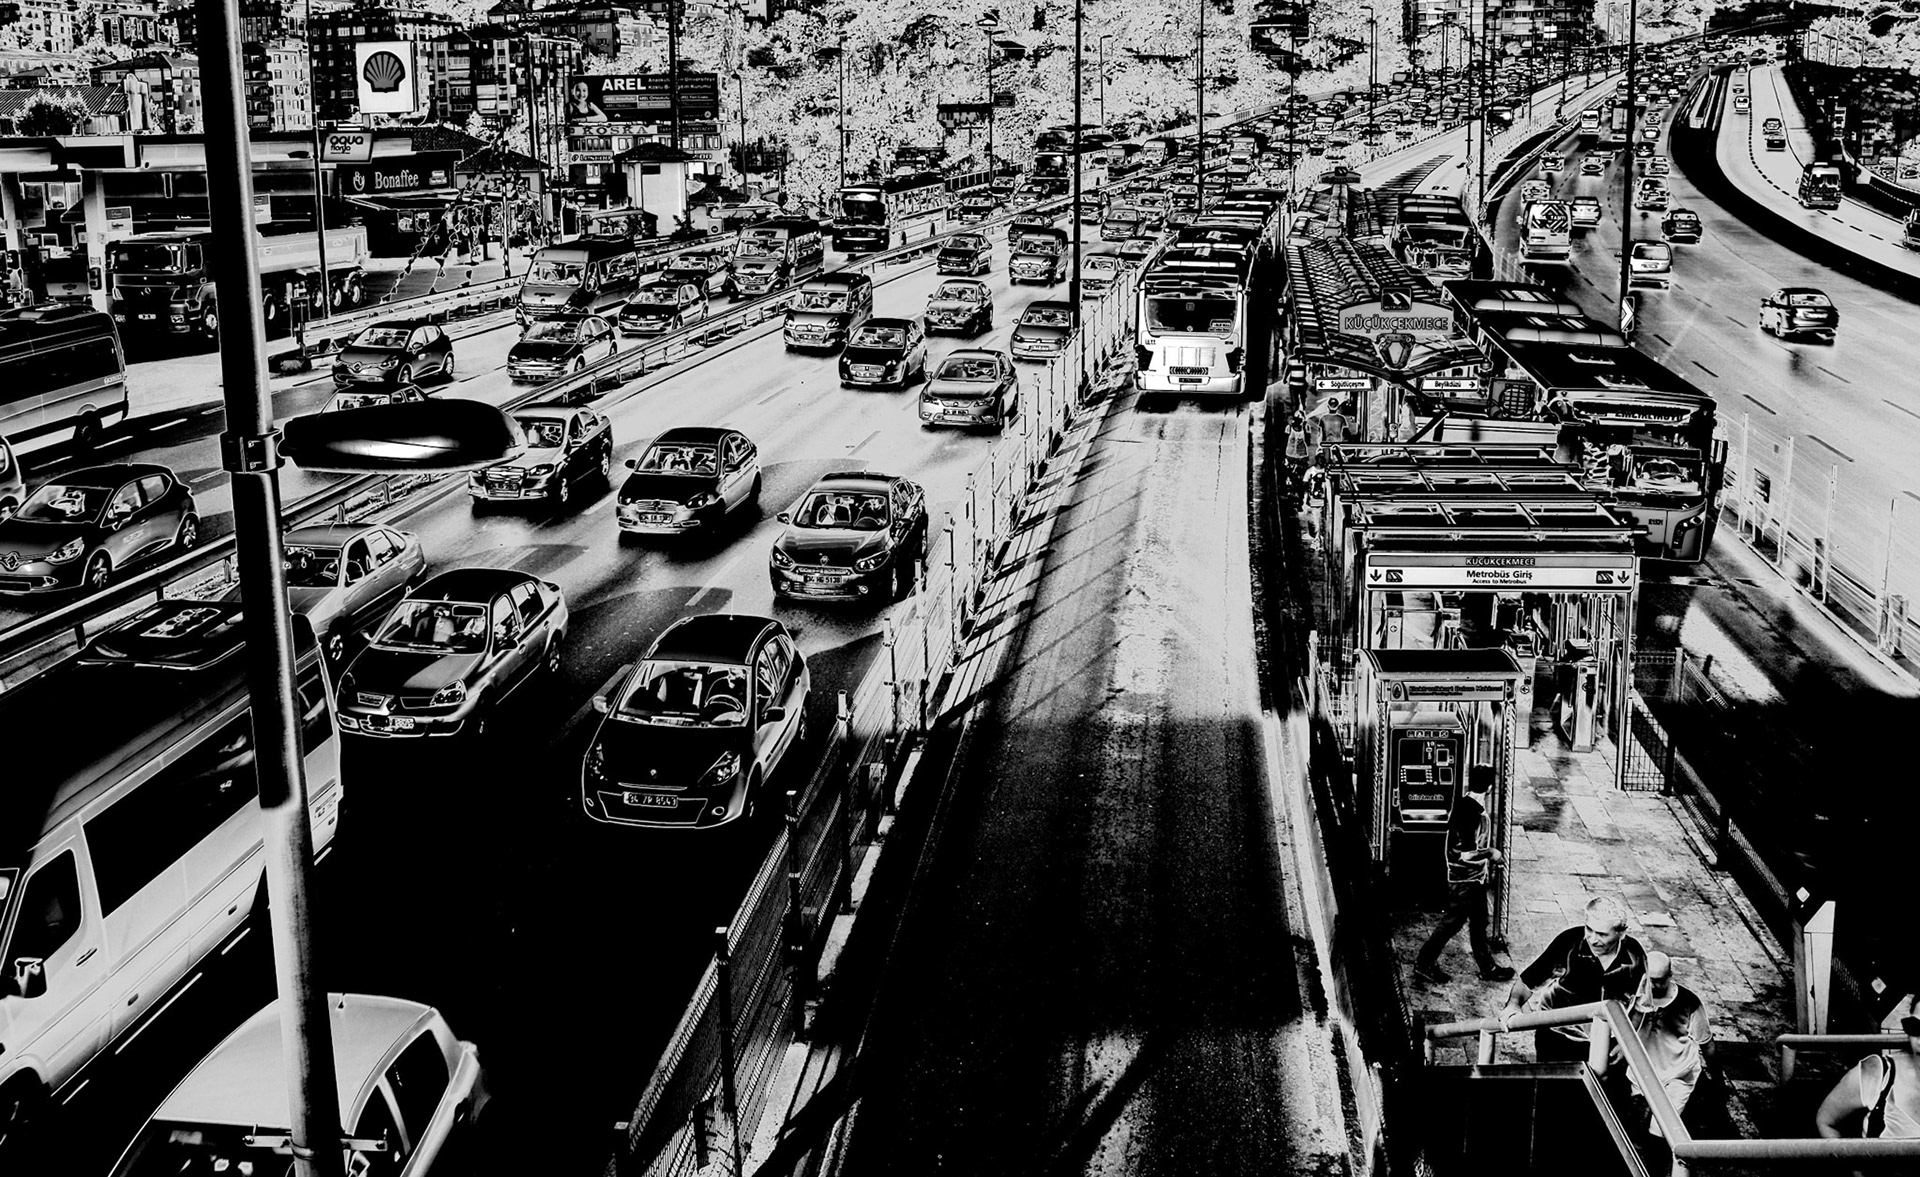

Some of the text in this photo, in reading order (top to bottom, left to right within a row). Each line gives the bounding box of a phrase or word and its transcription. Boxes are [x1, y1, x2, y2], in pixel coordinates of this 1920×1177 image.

[602, 78, 646, 91] AREL
[583, 126, 648, 135] KOSKA
[330, 136, 364, 147] aqua
[375, 169, 419, 189] Bonaffee
[1344, 314, 1449, 334] KÜÇÜKÇEKMECE
[1466, 570, 1533, 580] Metrobüs Giriş
